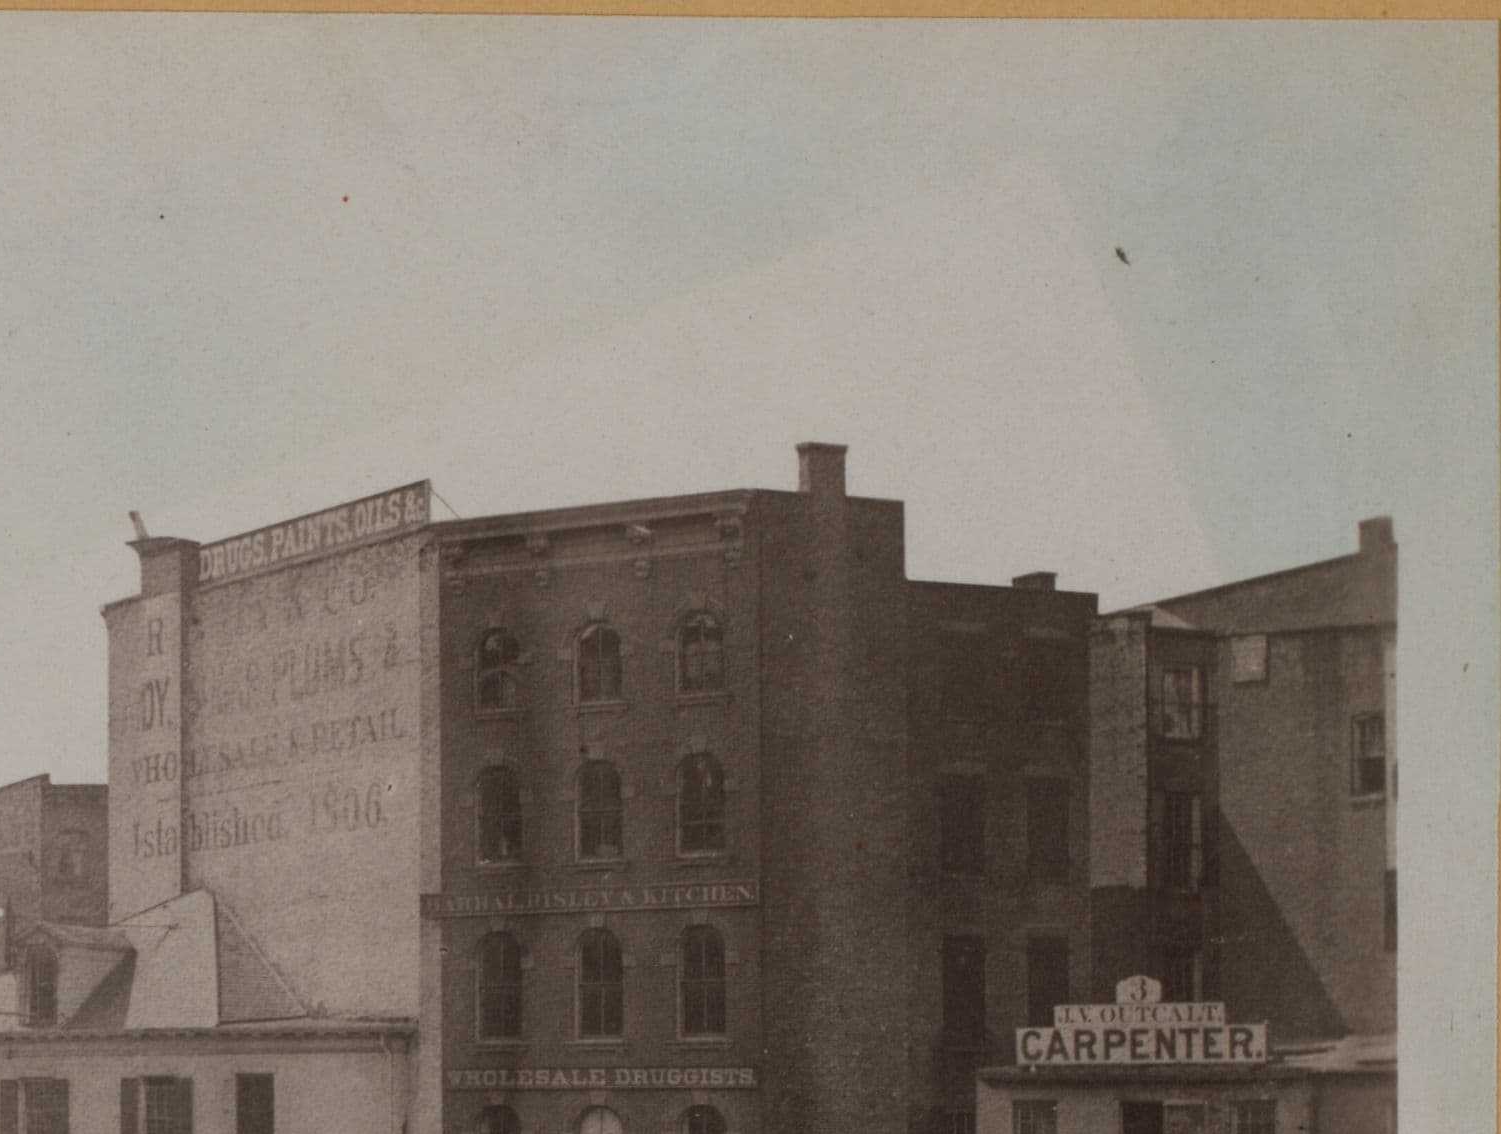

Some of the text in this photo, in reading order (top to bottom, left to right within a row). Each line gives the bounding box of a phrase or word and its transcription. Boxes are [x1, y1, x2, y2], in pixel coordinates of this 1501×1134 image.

[642, 886, 756, 905] KITCHEN.
[1129, 978, 1148, 1001] 3
[1020, 1027, 1263, 1061] CARPENTER.
[447, 1067, 758, 1088] WHOLESALE DRUGGISTS.
